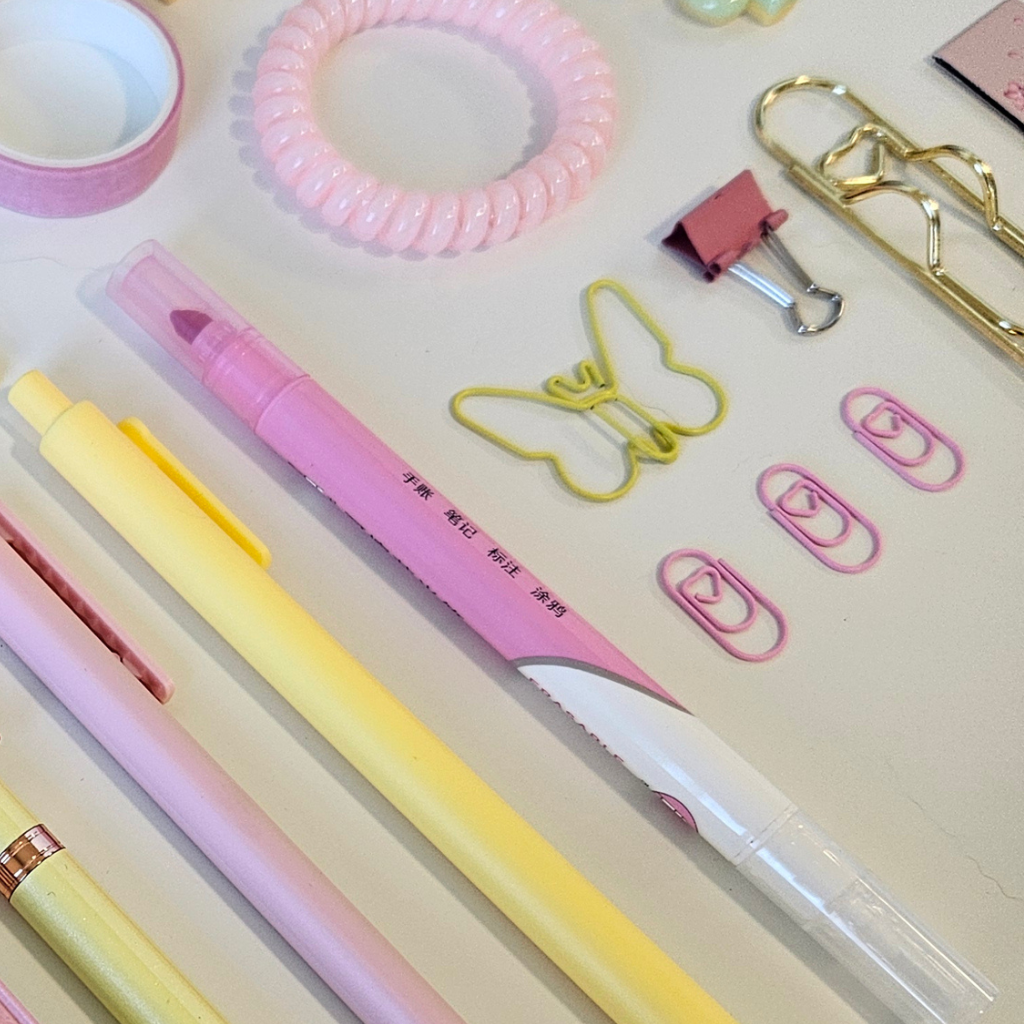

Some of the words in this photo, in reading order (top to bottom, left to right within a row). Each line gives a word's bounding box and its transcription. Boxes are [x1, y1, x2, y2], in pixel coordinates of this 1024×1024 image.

[402, 471, 435, 501] 手账
[443, 509, 478, 539] 笔记
[487, 547, 521, 579] 标注
[530, 586, 568, 618] 涂鸦
